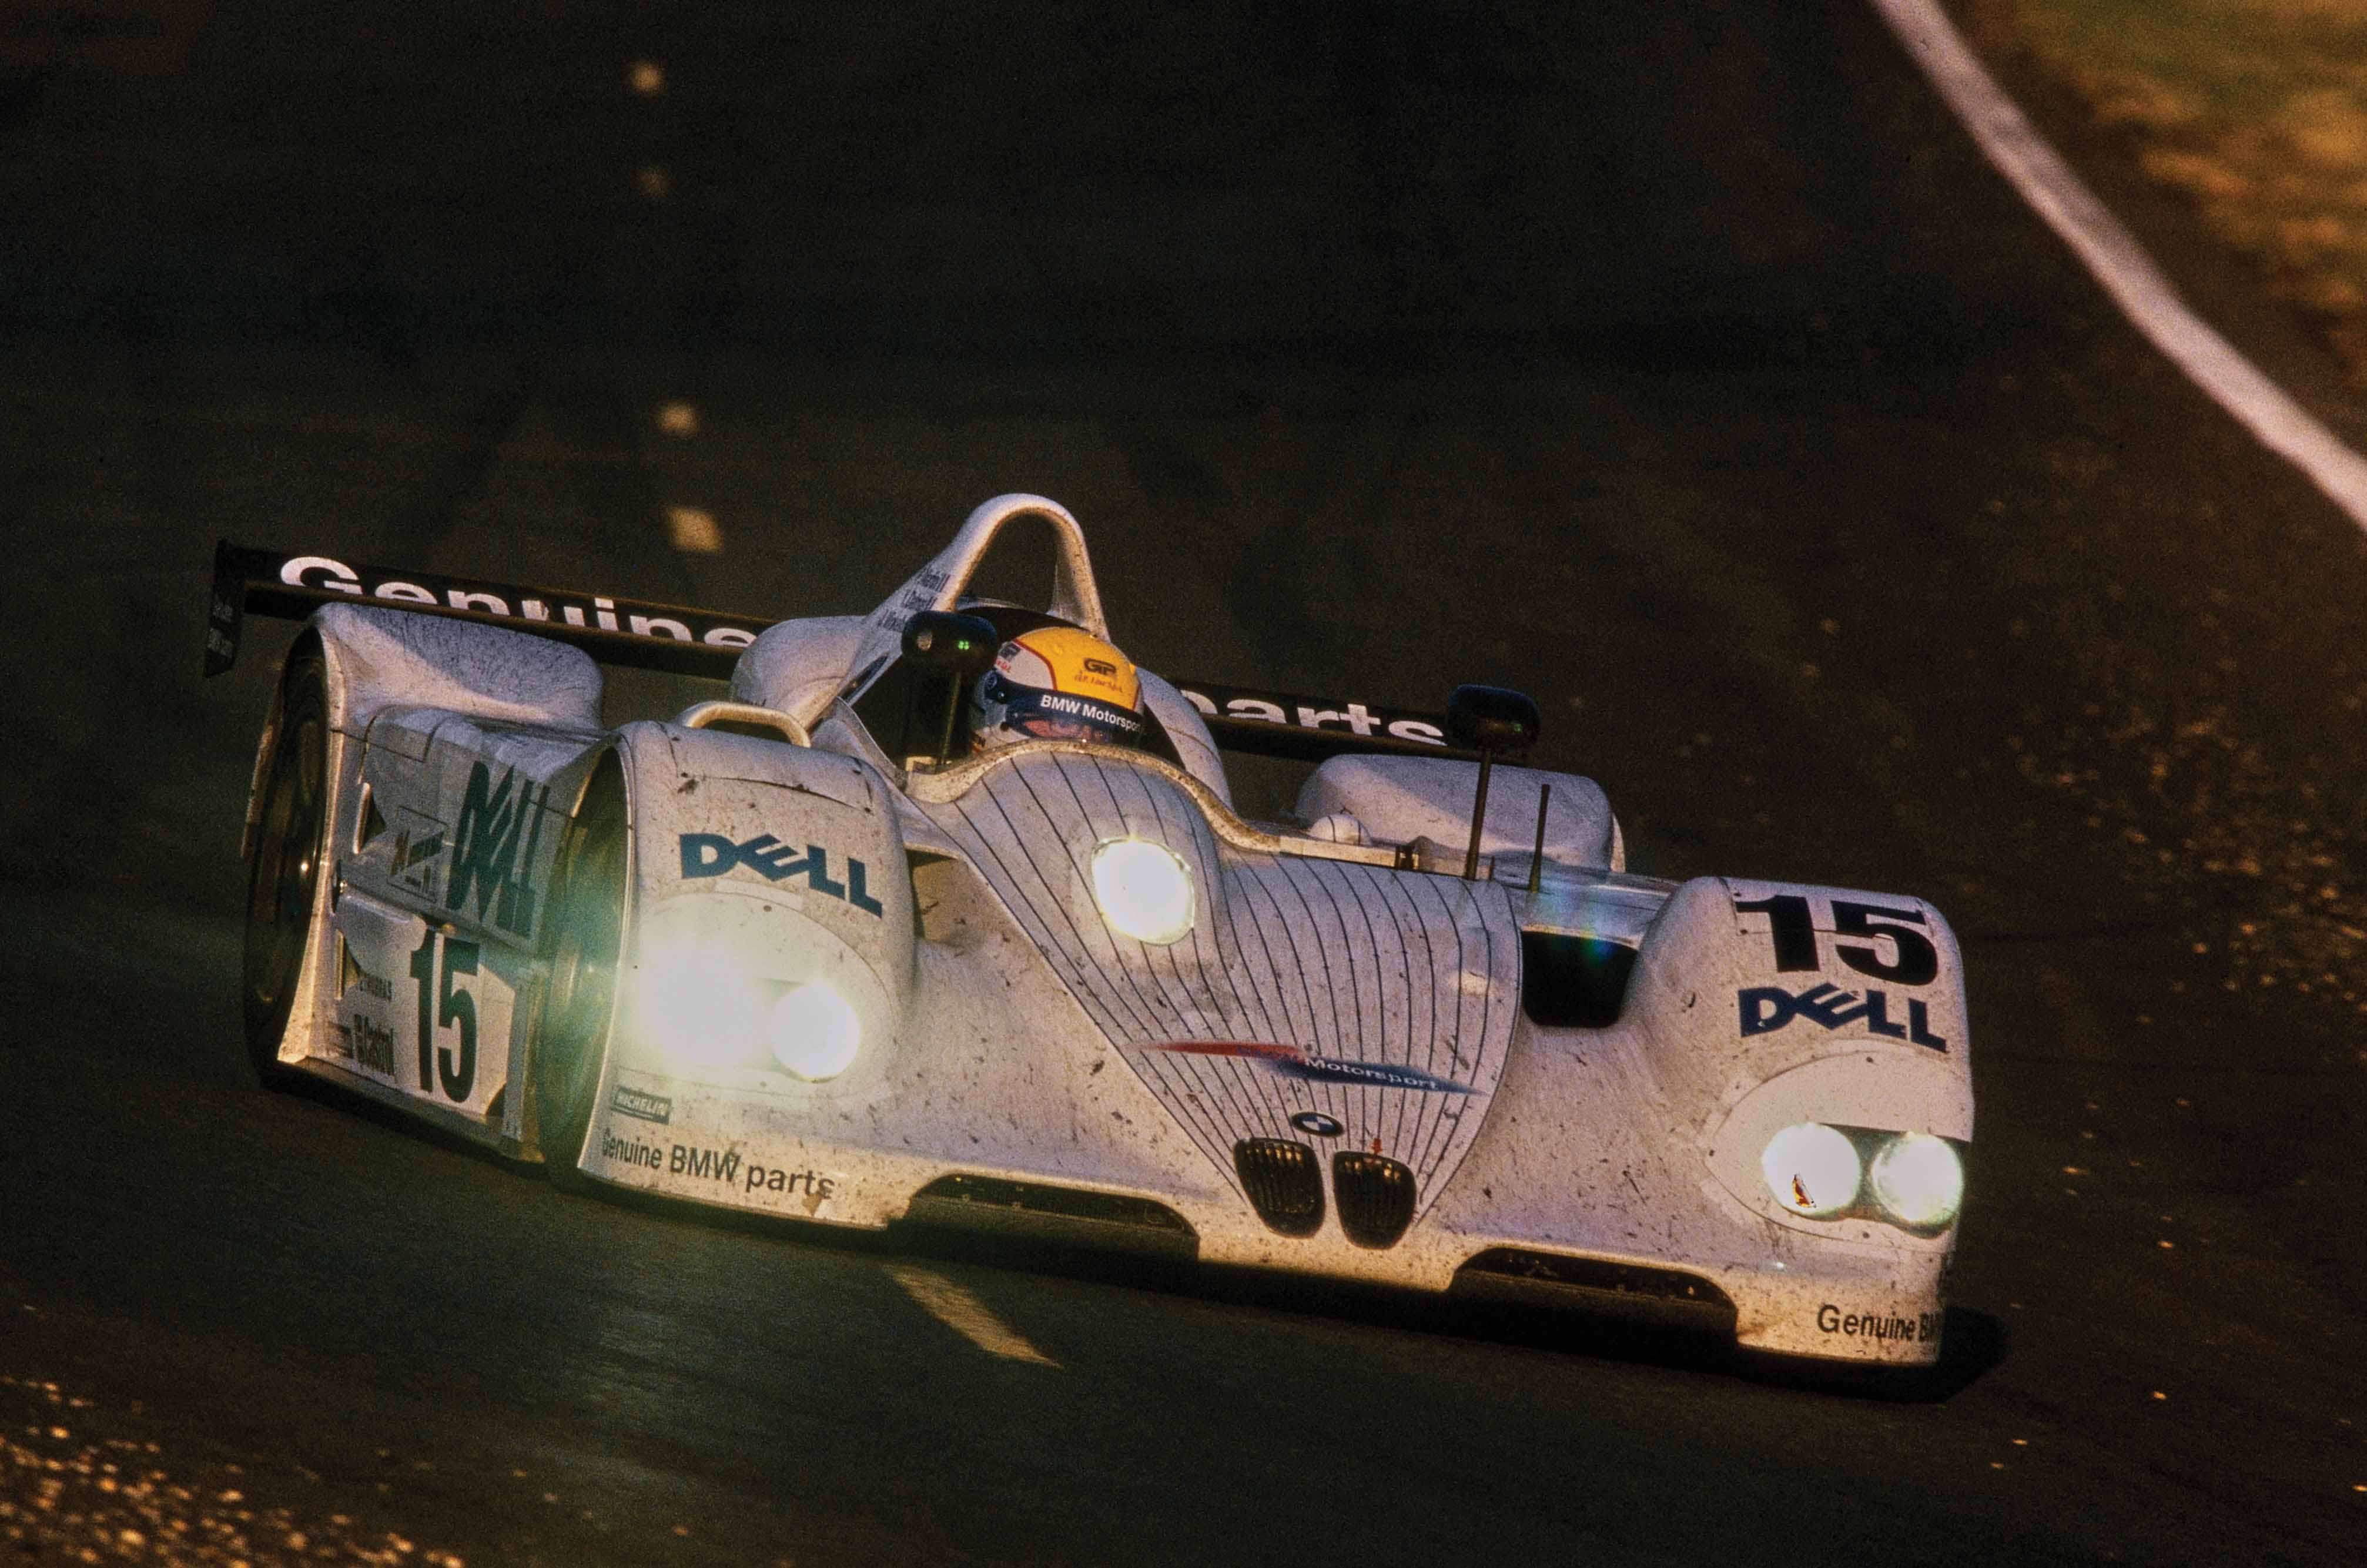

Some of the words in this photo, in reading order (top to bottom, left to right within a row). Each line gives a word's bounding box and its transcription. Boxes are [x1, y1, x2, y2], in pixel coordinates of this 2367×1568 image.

[1040, 694, 1080, 715] BMW
[679, 832, 882, 919] DELL
[1735, 894, 1939, 987] 15
[410, 928, 481, 1103] 15
[1737, 981, 1949, 1054] DELL
[1305, 1058, 1437, 1090] Motorsport
[602, 1134, 662, 1170] Genuine
[670, 1144, 741, 1184] BMW
[1817, 1304, 1916, 1342] Genuine
